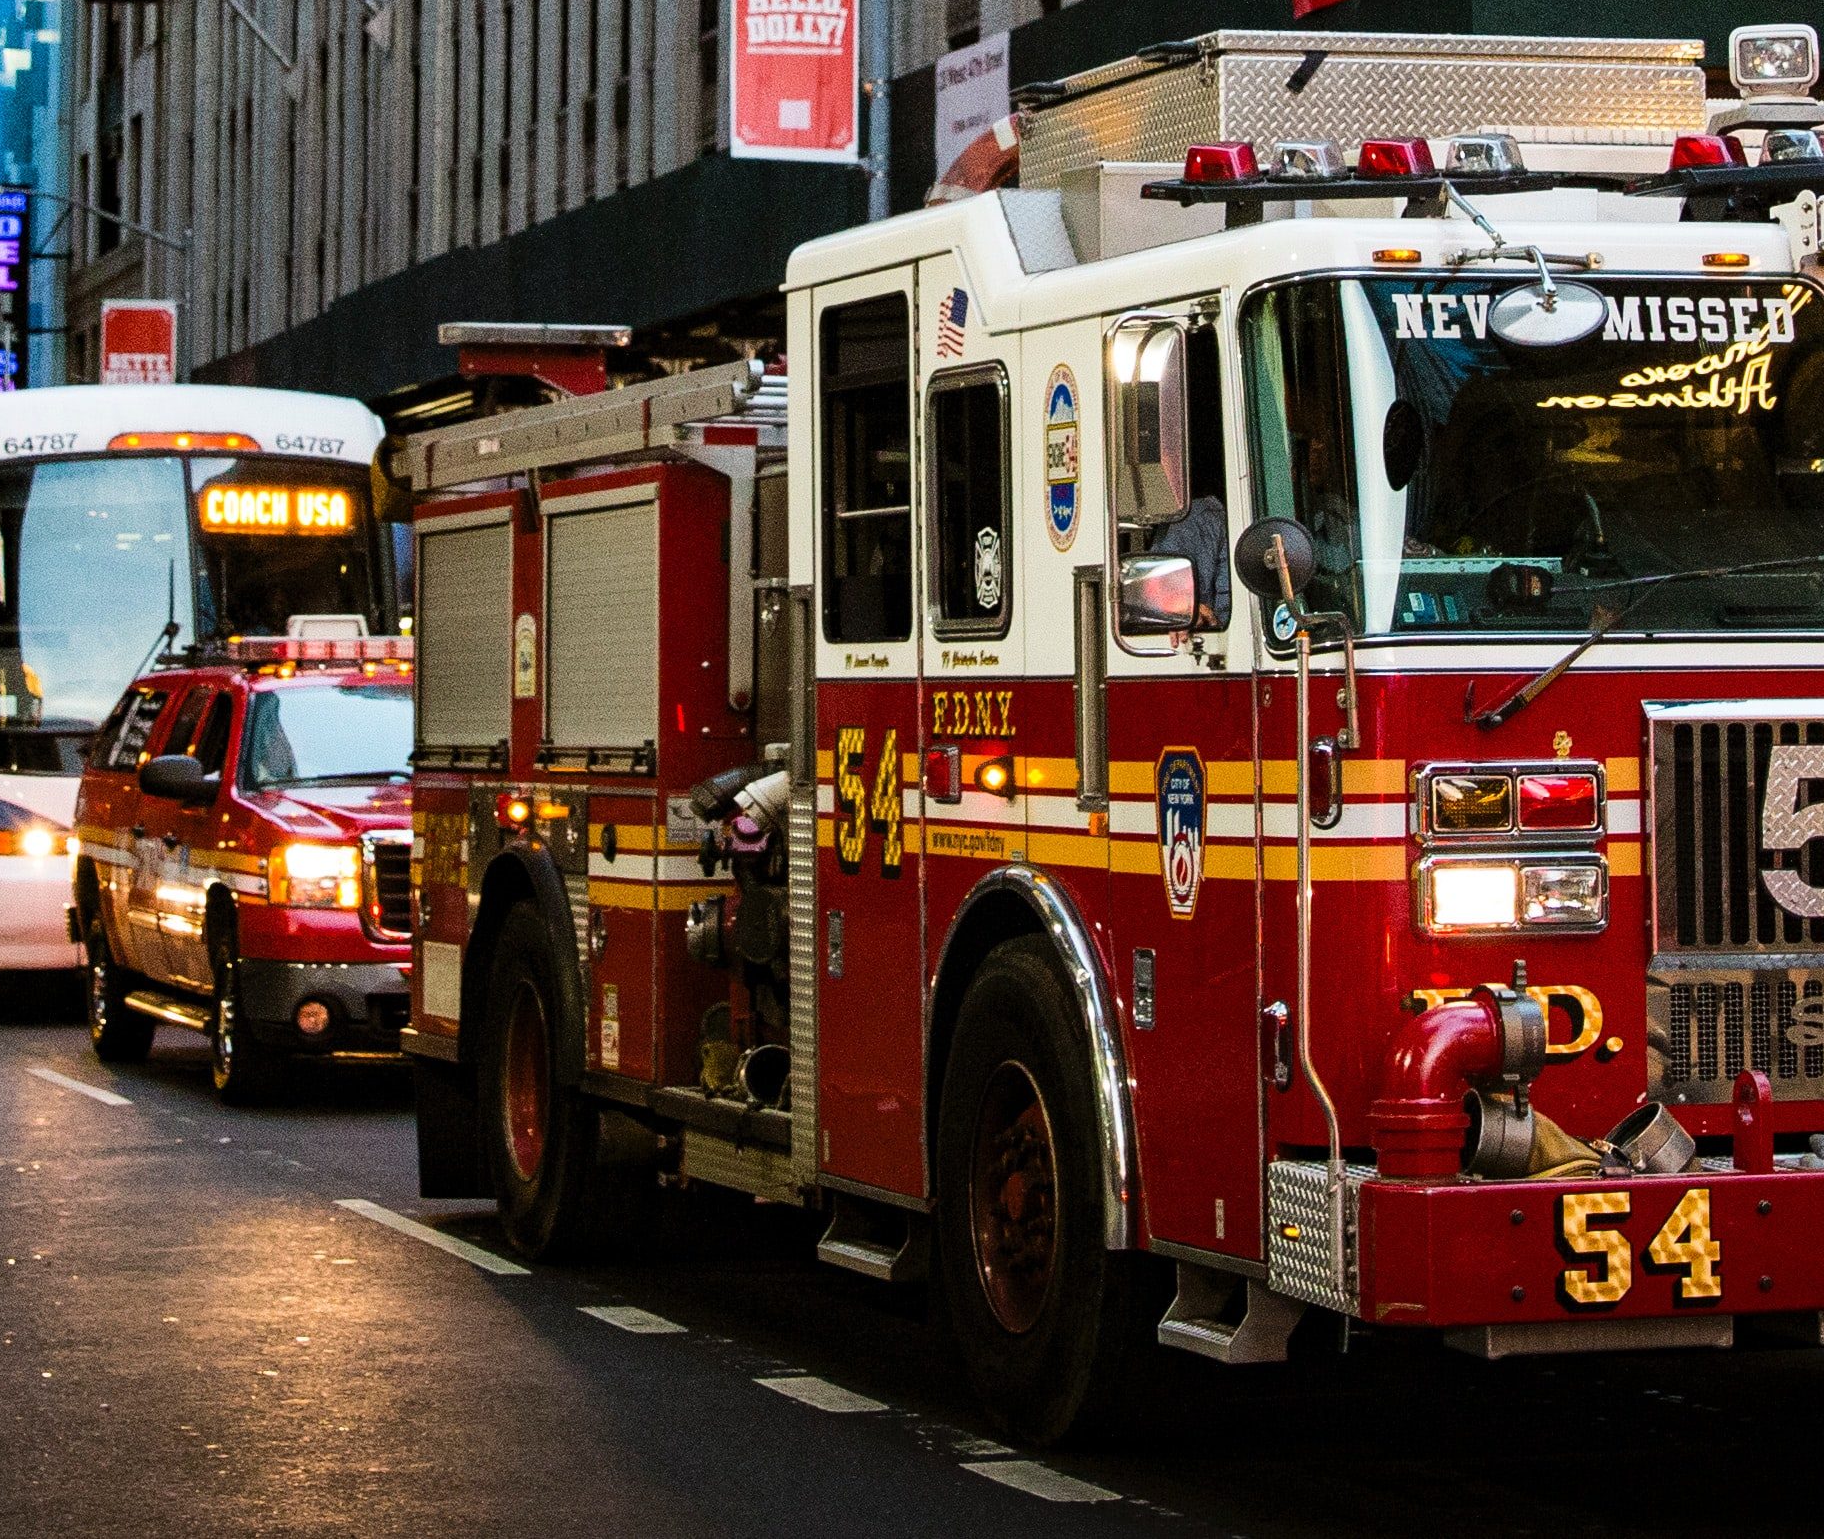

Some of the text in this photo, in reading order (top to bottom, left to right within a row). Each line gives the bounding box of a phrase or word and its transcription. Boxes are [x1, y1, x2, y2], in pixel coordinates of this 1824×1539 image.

[745, 14, 846, 47] DOLLY!
[1391, 293, 1494, 340] NEV
[1602, 297, 1795, 344] MISSED
[4, 433, 78, 455] 64787
[276, 433, 344, 456] 64787
[207, 489, 347, 527] COACH USA
[932, 691, 1016, 737] F.D.N.Y.
[837, 727, 902, 866] 54
[1562, 1188, 1722, 1303] 54
